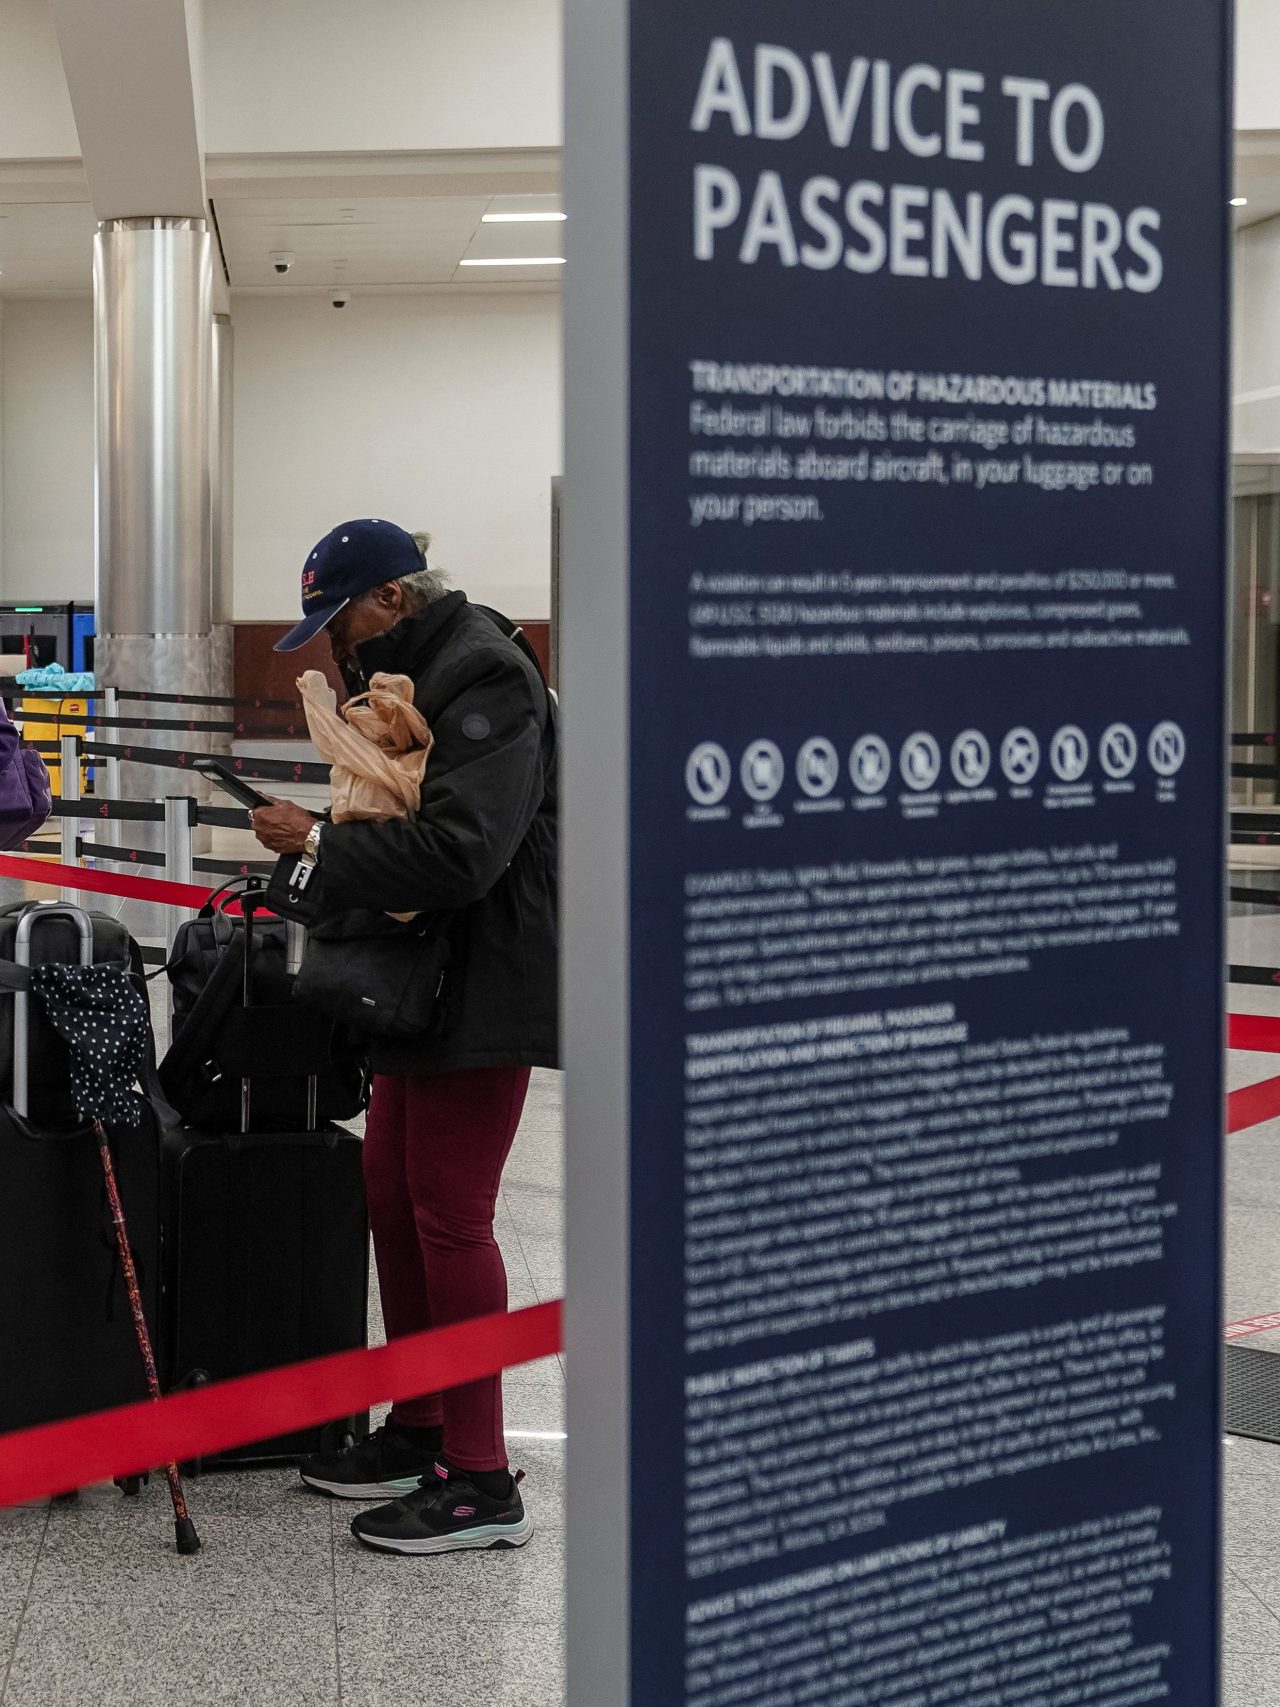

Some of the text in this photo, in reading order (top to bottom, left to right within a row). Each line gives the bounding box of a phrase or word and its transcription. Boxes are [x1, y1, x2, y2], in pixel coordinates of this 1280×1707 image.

[690, 36, 1106, 173] ADVICE TO
[692, 163, 1164, 293] PASSENGERS
[689, 360, 1157, 410] TRANSPORTATION OF HAZARDOUS MATERIALS
